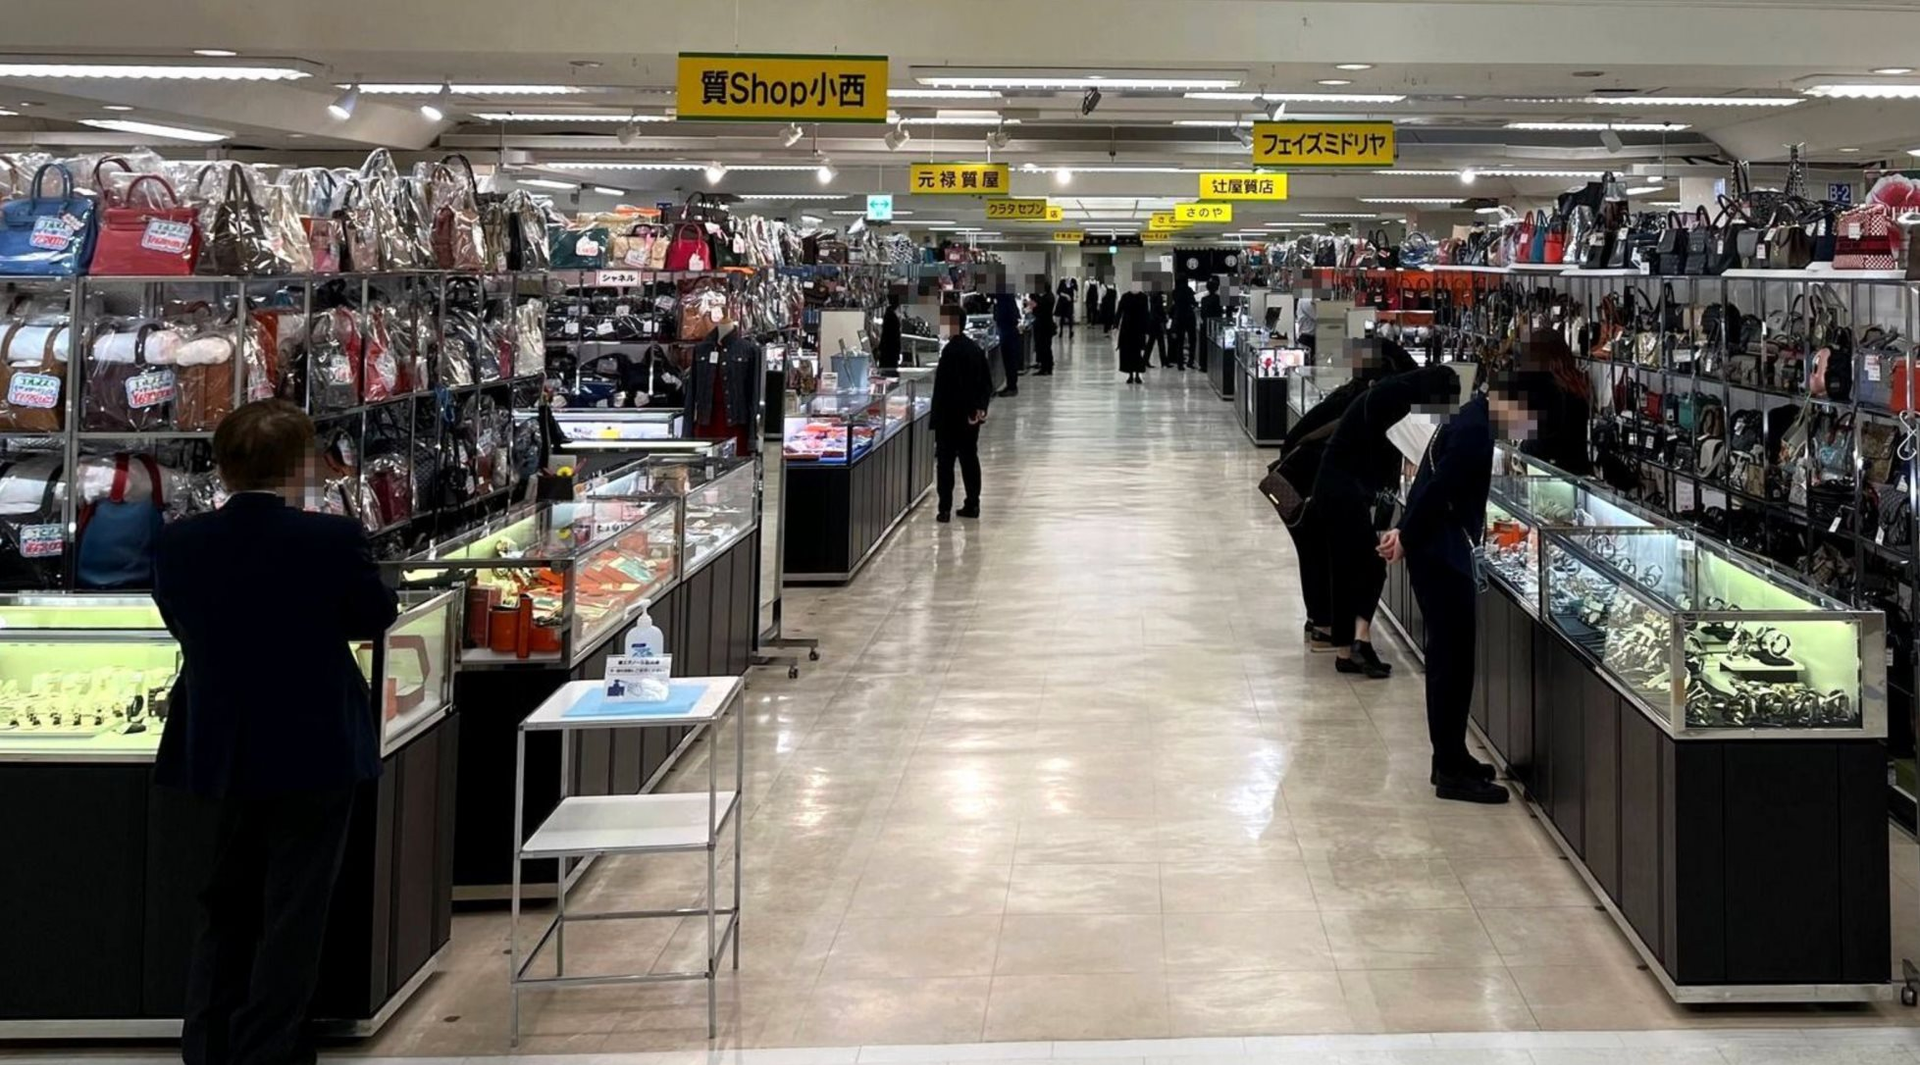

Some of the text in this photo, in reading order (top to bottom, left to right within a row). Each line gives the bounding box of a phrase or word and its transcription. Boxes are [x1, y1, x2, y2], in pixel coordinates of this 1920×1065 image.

[701, 70, 866, 108] 質Shop小西
[1261, 132, 1386, 156] フェイズミドリヤ
[918, 171, 999, 189] 元禄質屋
[1212, 179, 1273, 194] 辻屋質店
[1829, 185, 1850, 202] B-2
[1186, 207, 1223, 218] さのや
[602, 274, 635, 282] シャネル
